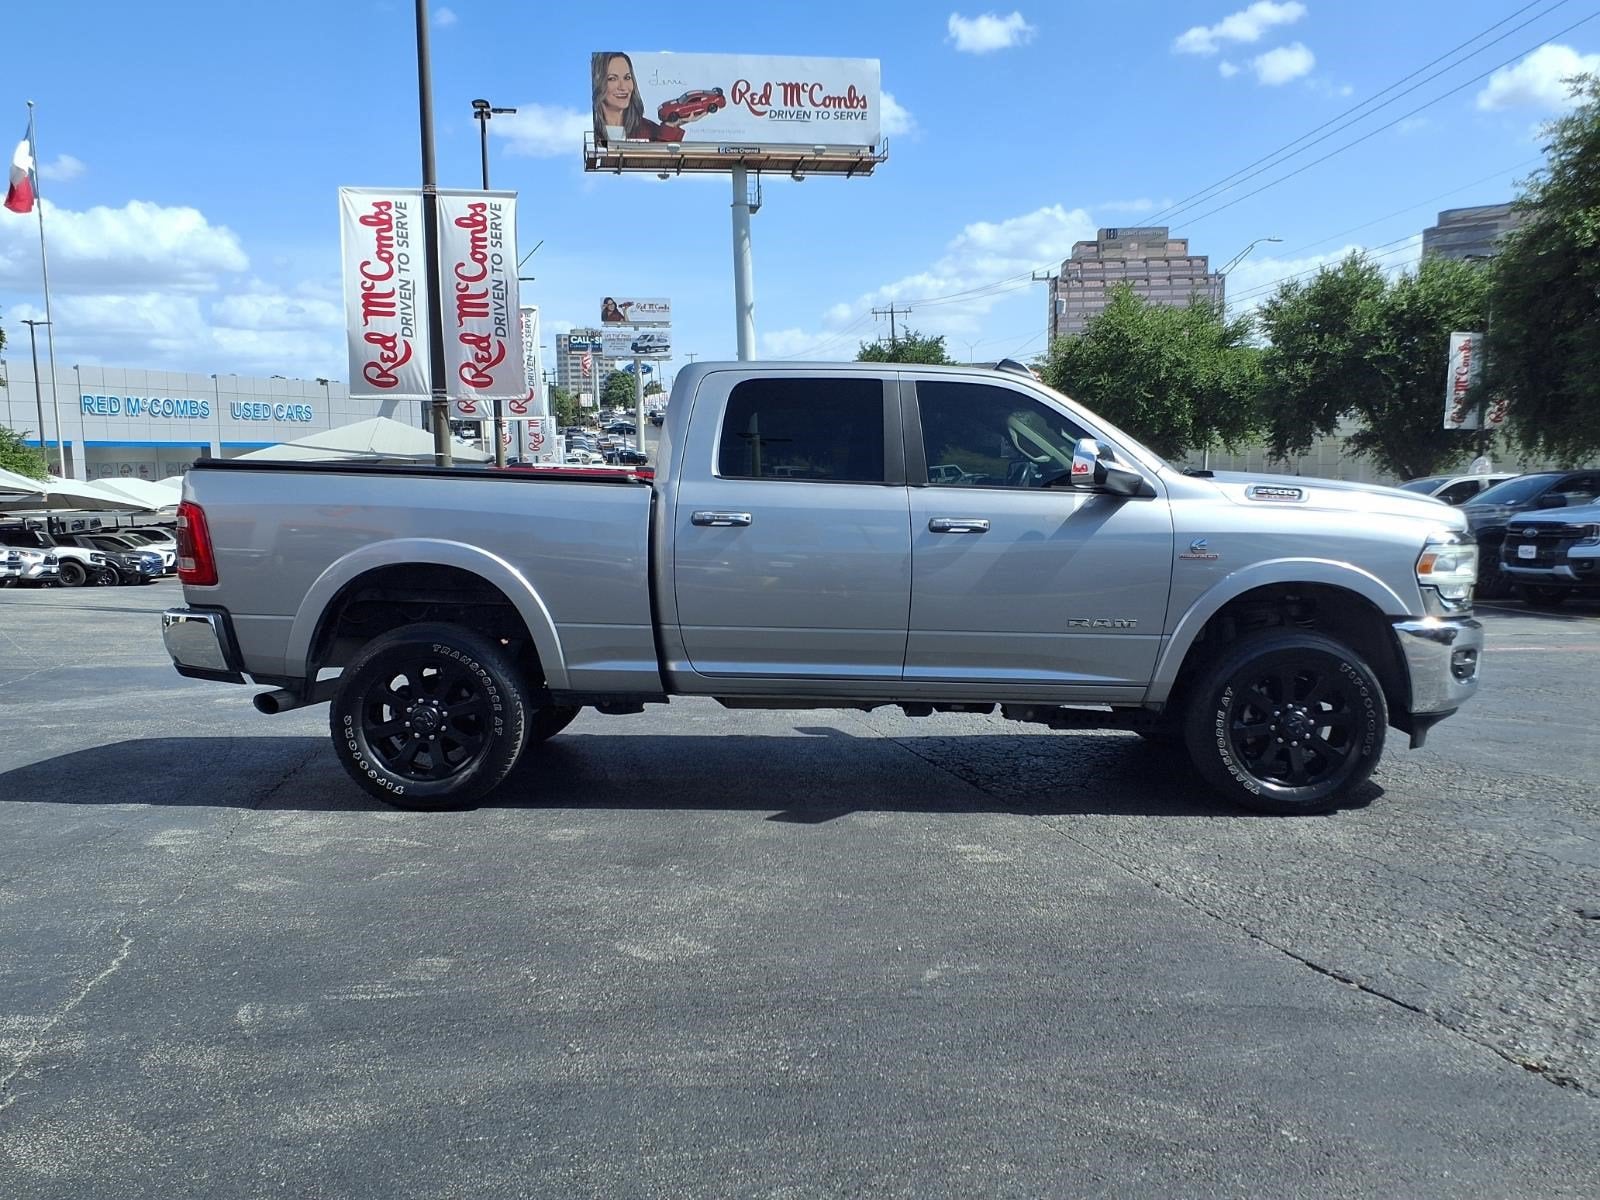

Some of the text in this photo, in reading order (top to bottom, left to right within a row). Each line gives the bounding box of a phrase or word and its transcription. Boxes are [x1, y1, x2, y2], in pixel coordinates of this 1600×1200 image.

[731, 79, 868, 117] Red McCombs
[768, 109, 868, 121] DRIVEN TO SERVE
[395, 201, 414, 338] DRIVEN TO SERVE
[454, 202, 489, 327] McCombs
[490, 202, 507, 338] DRIVEN TO SERVE
[359, 200, 412, 388] Red McCombs
[458, 331, 506, 389] Red
[524, 313, 535, 387] DRIVEN TO SERVE
[82, 394, 121, 415] RED
[231, 401, 271, 419] USED
[274, 402, 313, 421] CARS
[528, 431, 545, 452] Red
[1067, 618, 1137, 628] RAM
[432, 643, 504, 737] TRANSFORCE AT
[1221, 686, 1234, 708] AT
